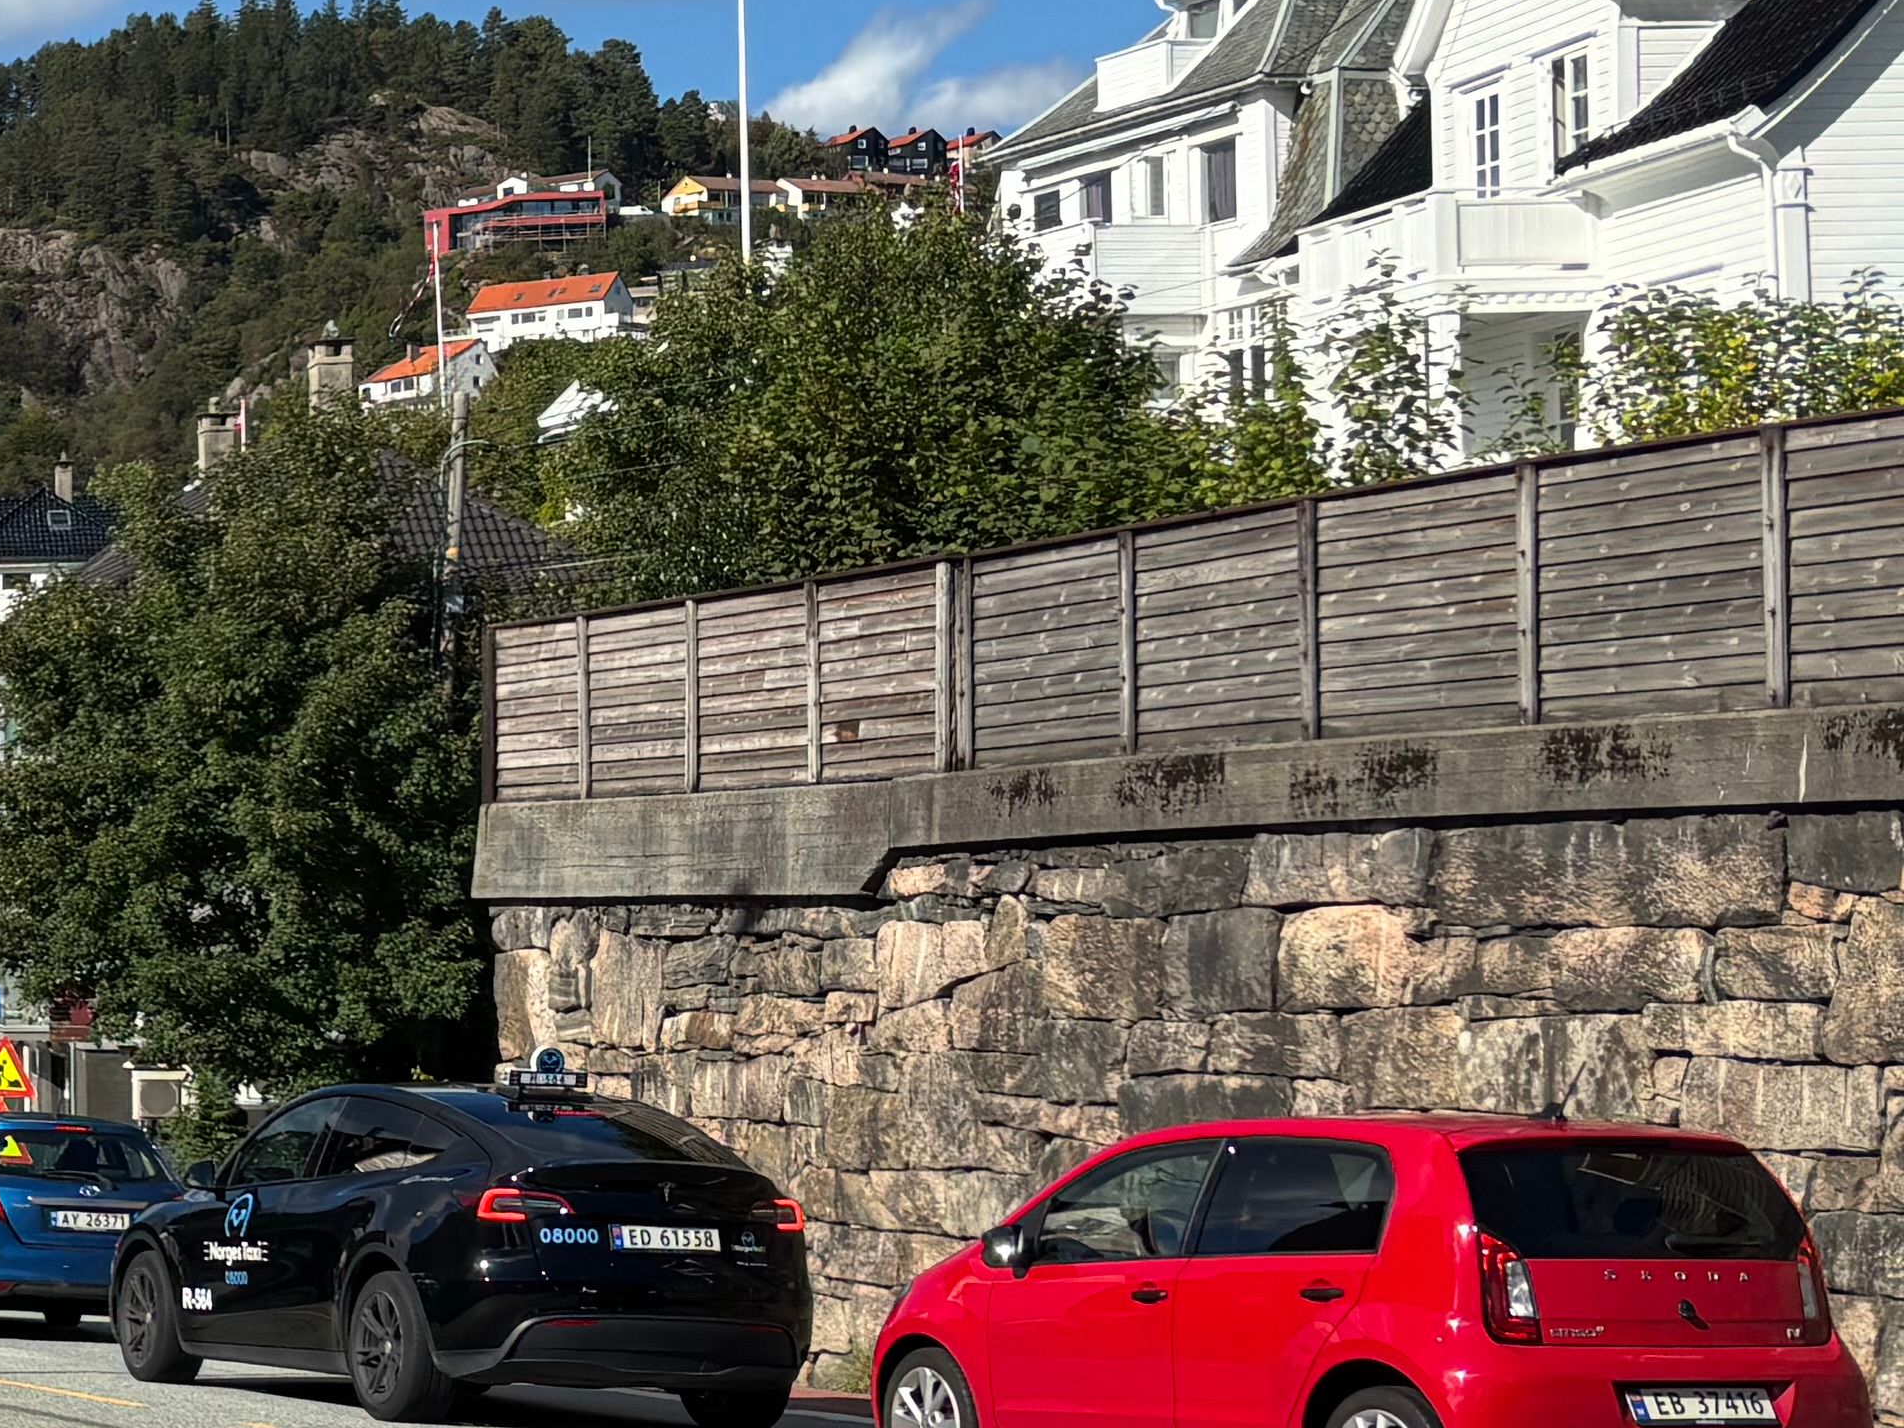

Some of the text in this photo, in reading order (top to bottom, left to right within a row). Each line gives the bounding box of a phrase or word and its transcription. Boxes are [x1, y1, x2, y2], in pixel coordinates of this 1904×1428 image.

[61, 1213, 126, 1228] AY 26371
[539, 1228, 599, 1244] 08000
[629, 1229, 714, 1248] ED 61558
[1653, 1390, 1765, 1416] EB 37416
